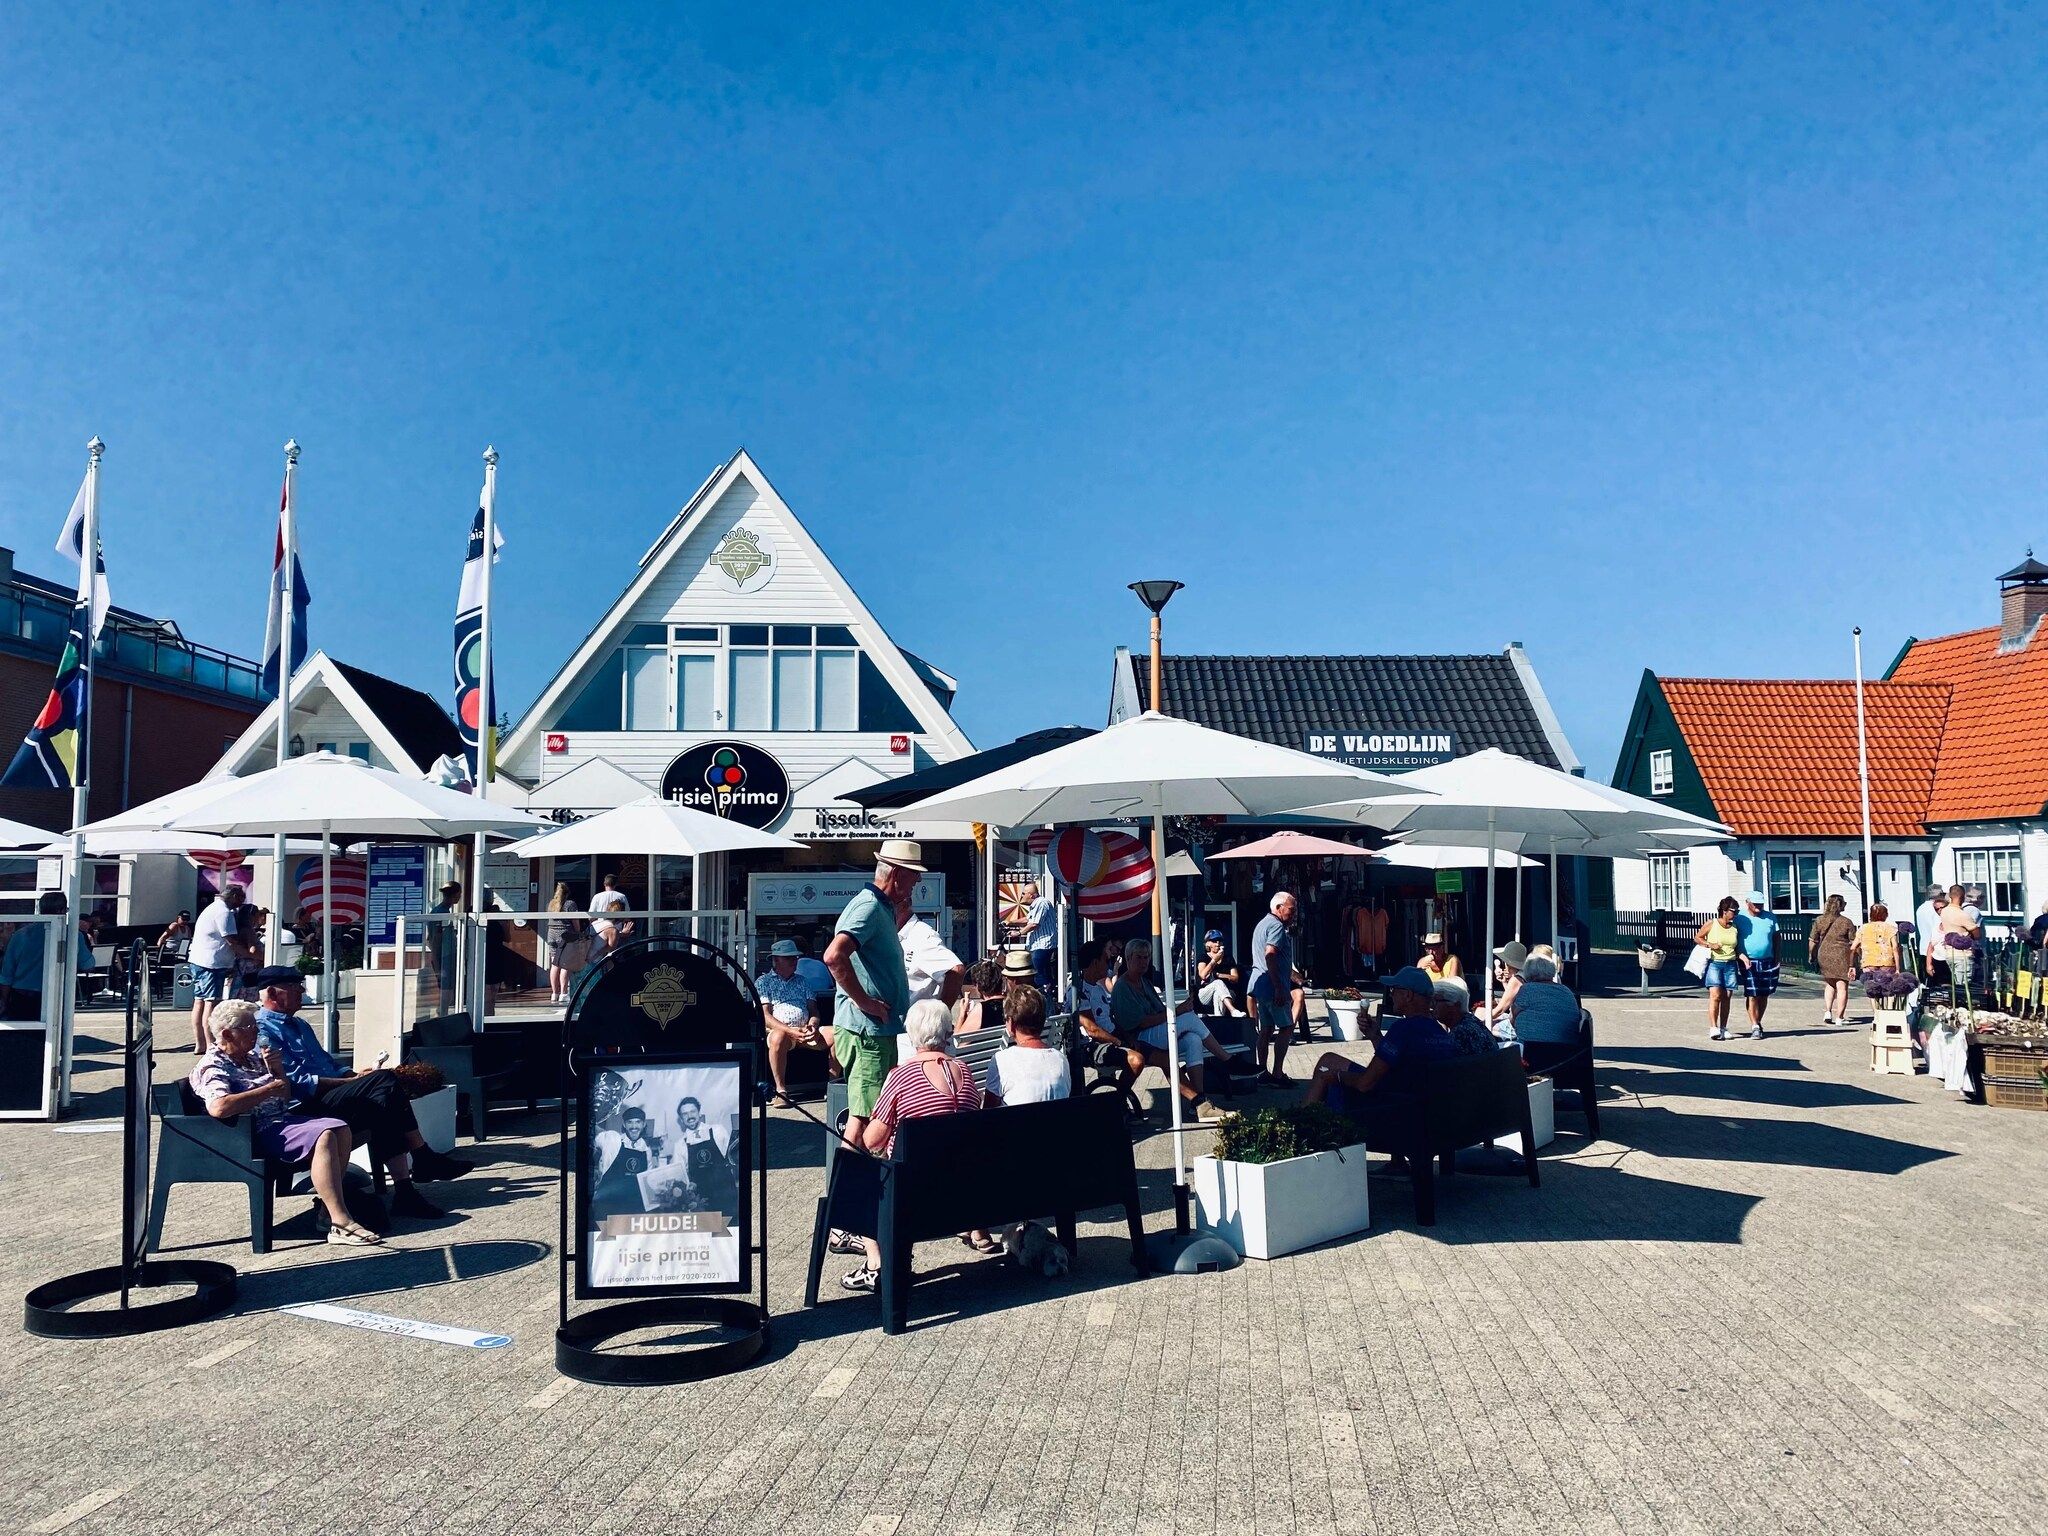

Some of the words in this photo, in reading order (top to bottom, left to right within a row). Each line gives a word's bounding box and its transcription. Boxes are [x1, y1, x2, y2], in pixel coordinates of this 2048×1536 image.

[548, 737, 564, 749] illy
[892, 738, 906, 750] illy
[1309, 735, 1336, 752] DE
[1343, 735, 1450, 752] VLOEDLIJN
[672, 787, 712, 806] ijsie
[719, 787, 778, 809] prima
[631, 1215, 697, 1232] HULDE!
[619, 1248, 652, 1266] ijsie
[659, 1247, 710, 1265] prima
